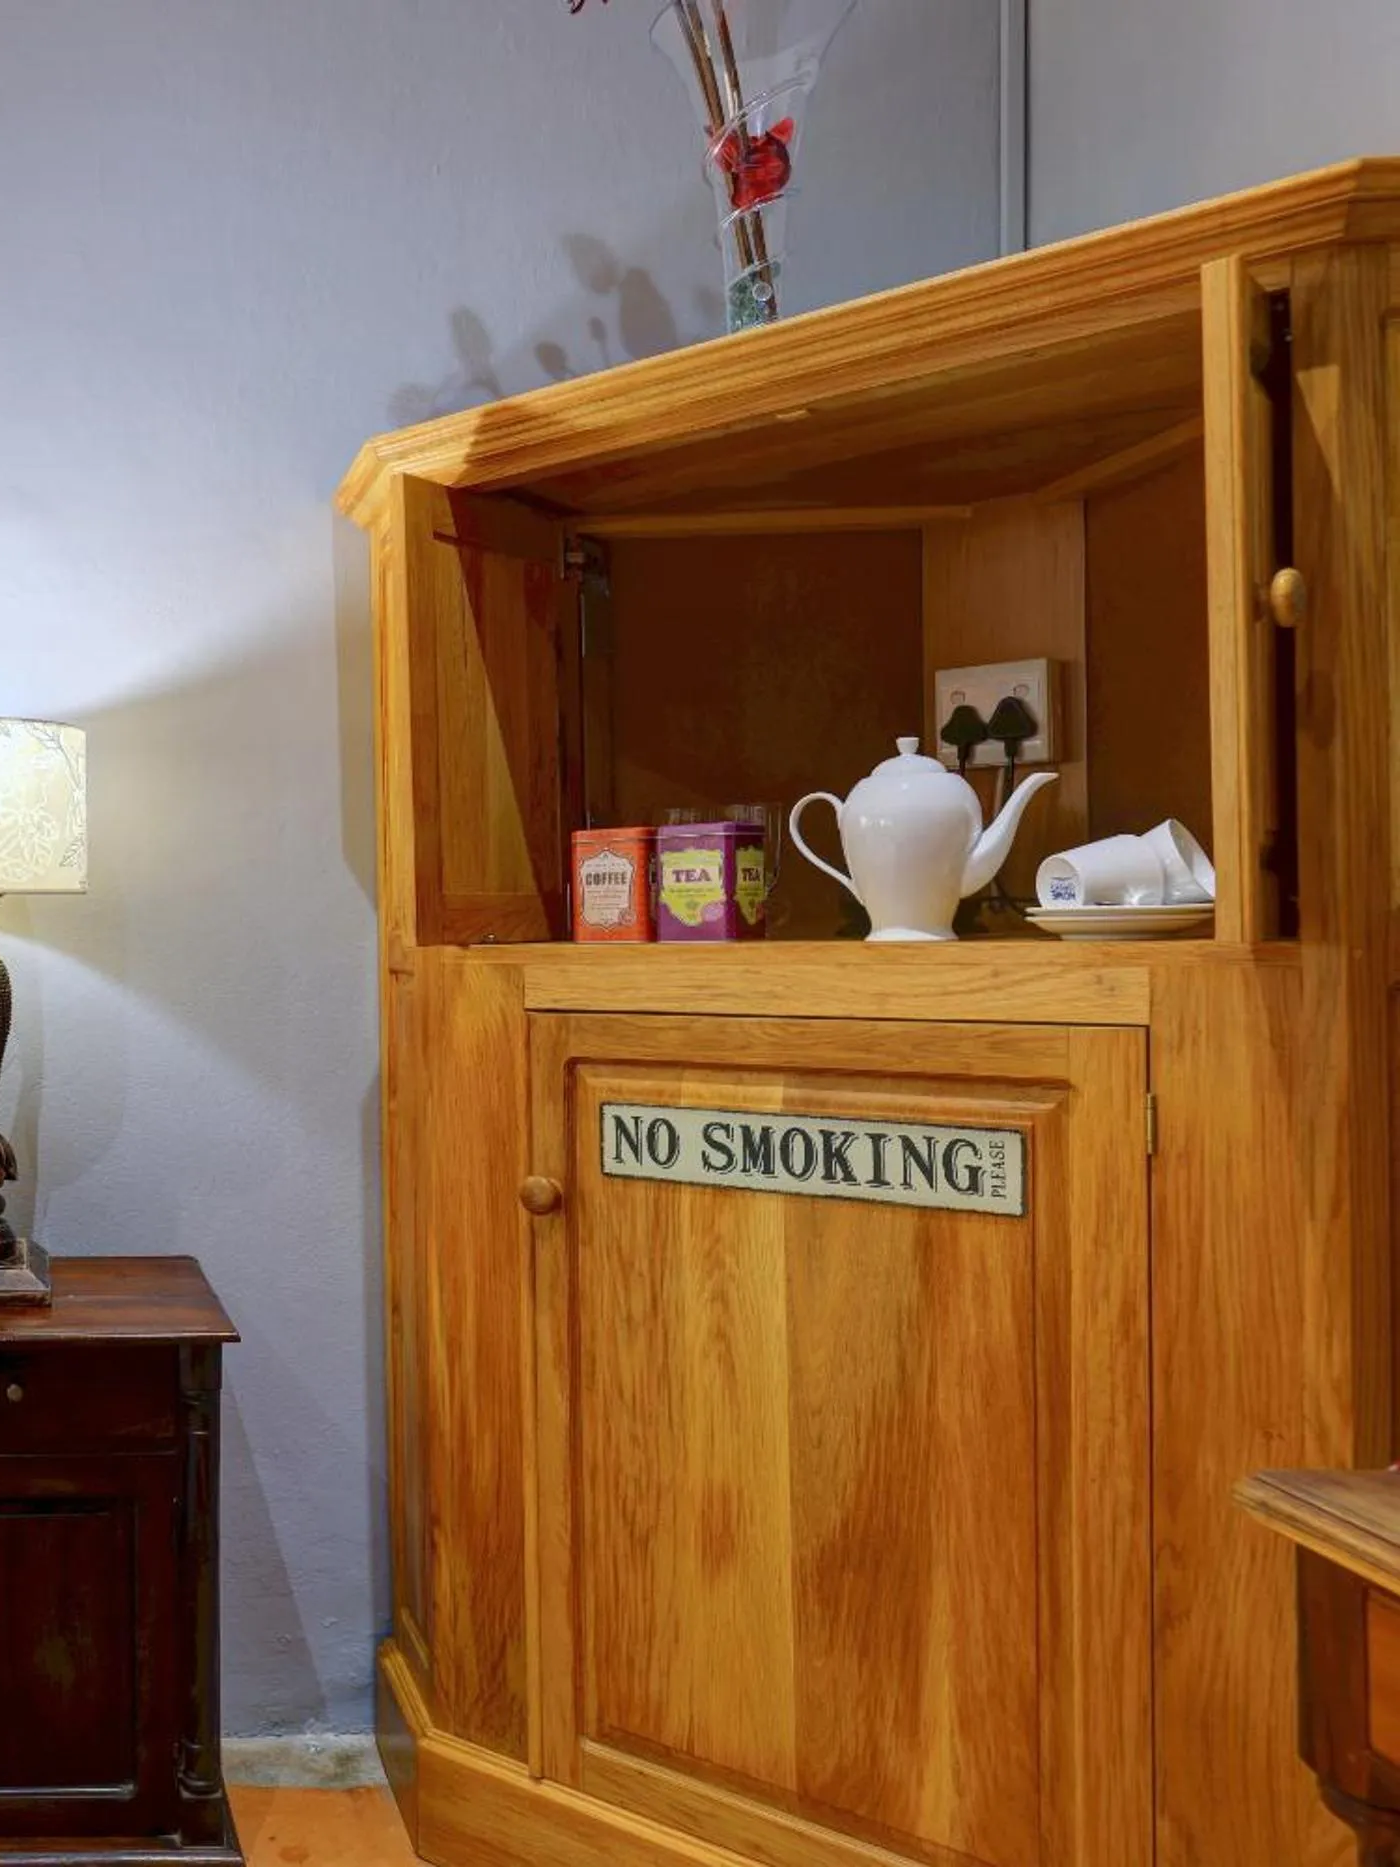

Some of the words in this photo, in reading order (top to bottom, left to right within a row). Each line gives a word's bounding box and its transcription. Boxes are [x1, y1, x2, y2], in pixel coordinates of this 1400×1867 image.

[585, 872, 627, 886] COFFEE
[672, 869, 712, 883] TEA
[741, 868, 761, 882] TEA
[612, 1114, 680, 1169] NO
[701, 1121, 985, 1198] SMOKING
[990, 1139, 1007, 1199] PLEASE
